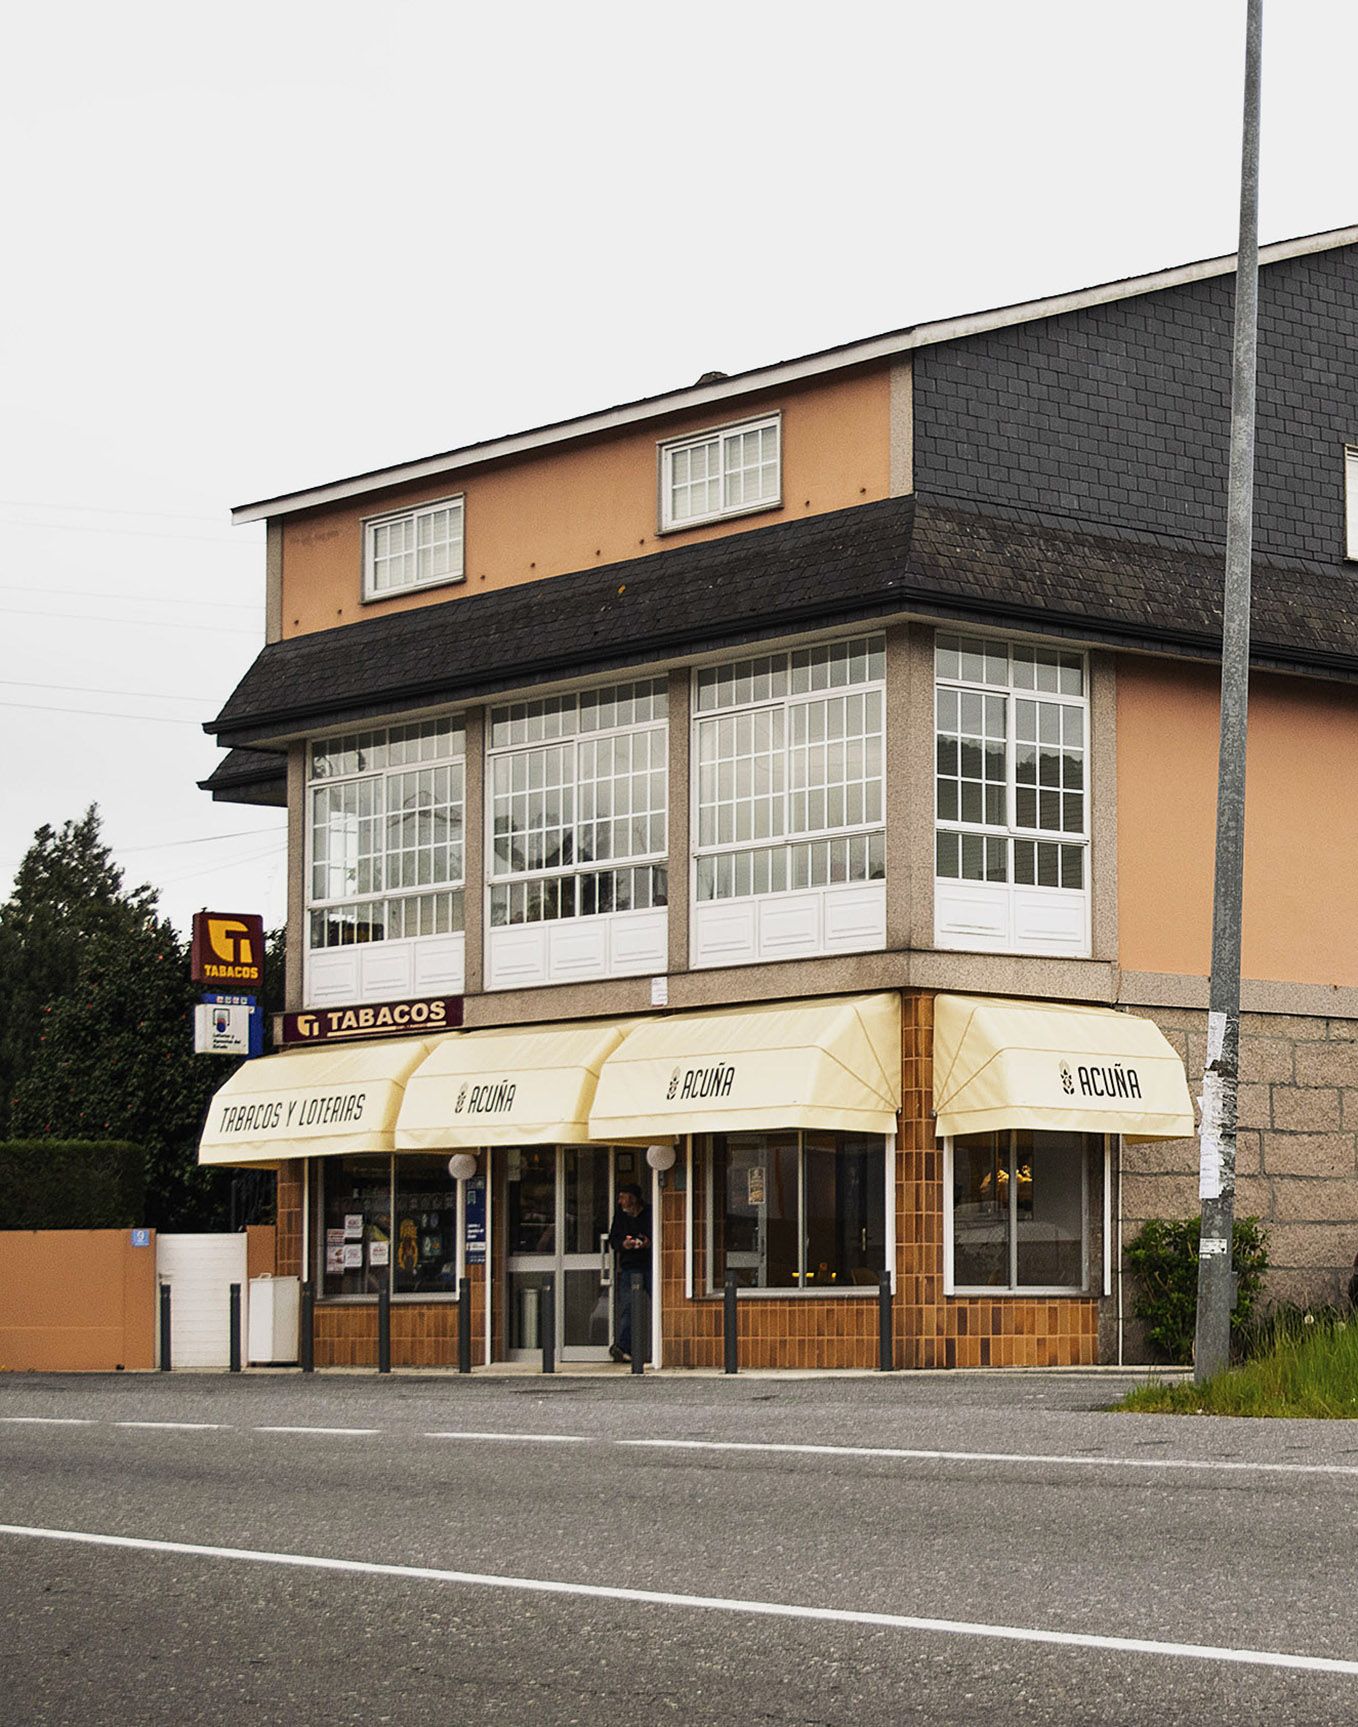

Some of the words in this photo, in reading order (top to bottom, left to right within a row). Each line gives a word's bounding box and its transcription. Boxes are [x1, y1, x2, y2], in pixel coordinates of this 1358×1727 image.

[204, 964, 258, 979] TABACOS
[327, 1001, 447, 1030] TABACOS
[467, 1079, 517, 1114] ACUÑA
[680, 1061, 735, 1100] ACUÑA
[1077, 1063, 1142, 1099] ACUÑA
[220, 1102, 283, 1133] TABACOS
[286, 1100, 298, 1127] Y
[298, 1093, 366, 1126] LOTERIAS
